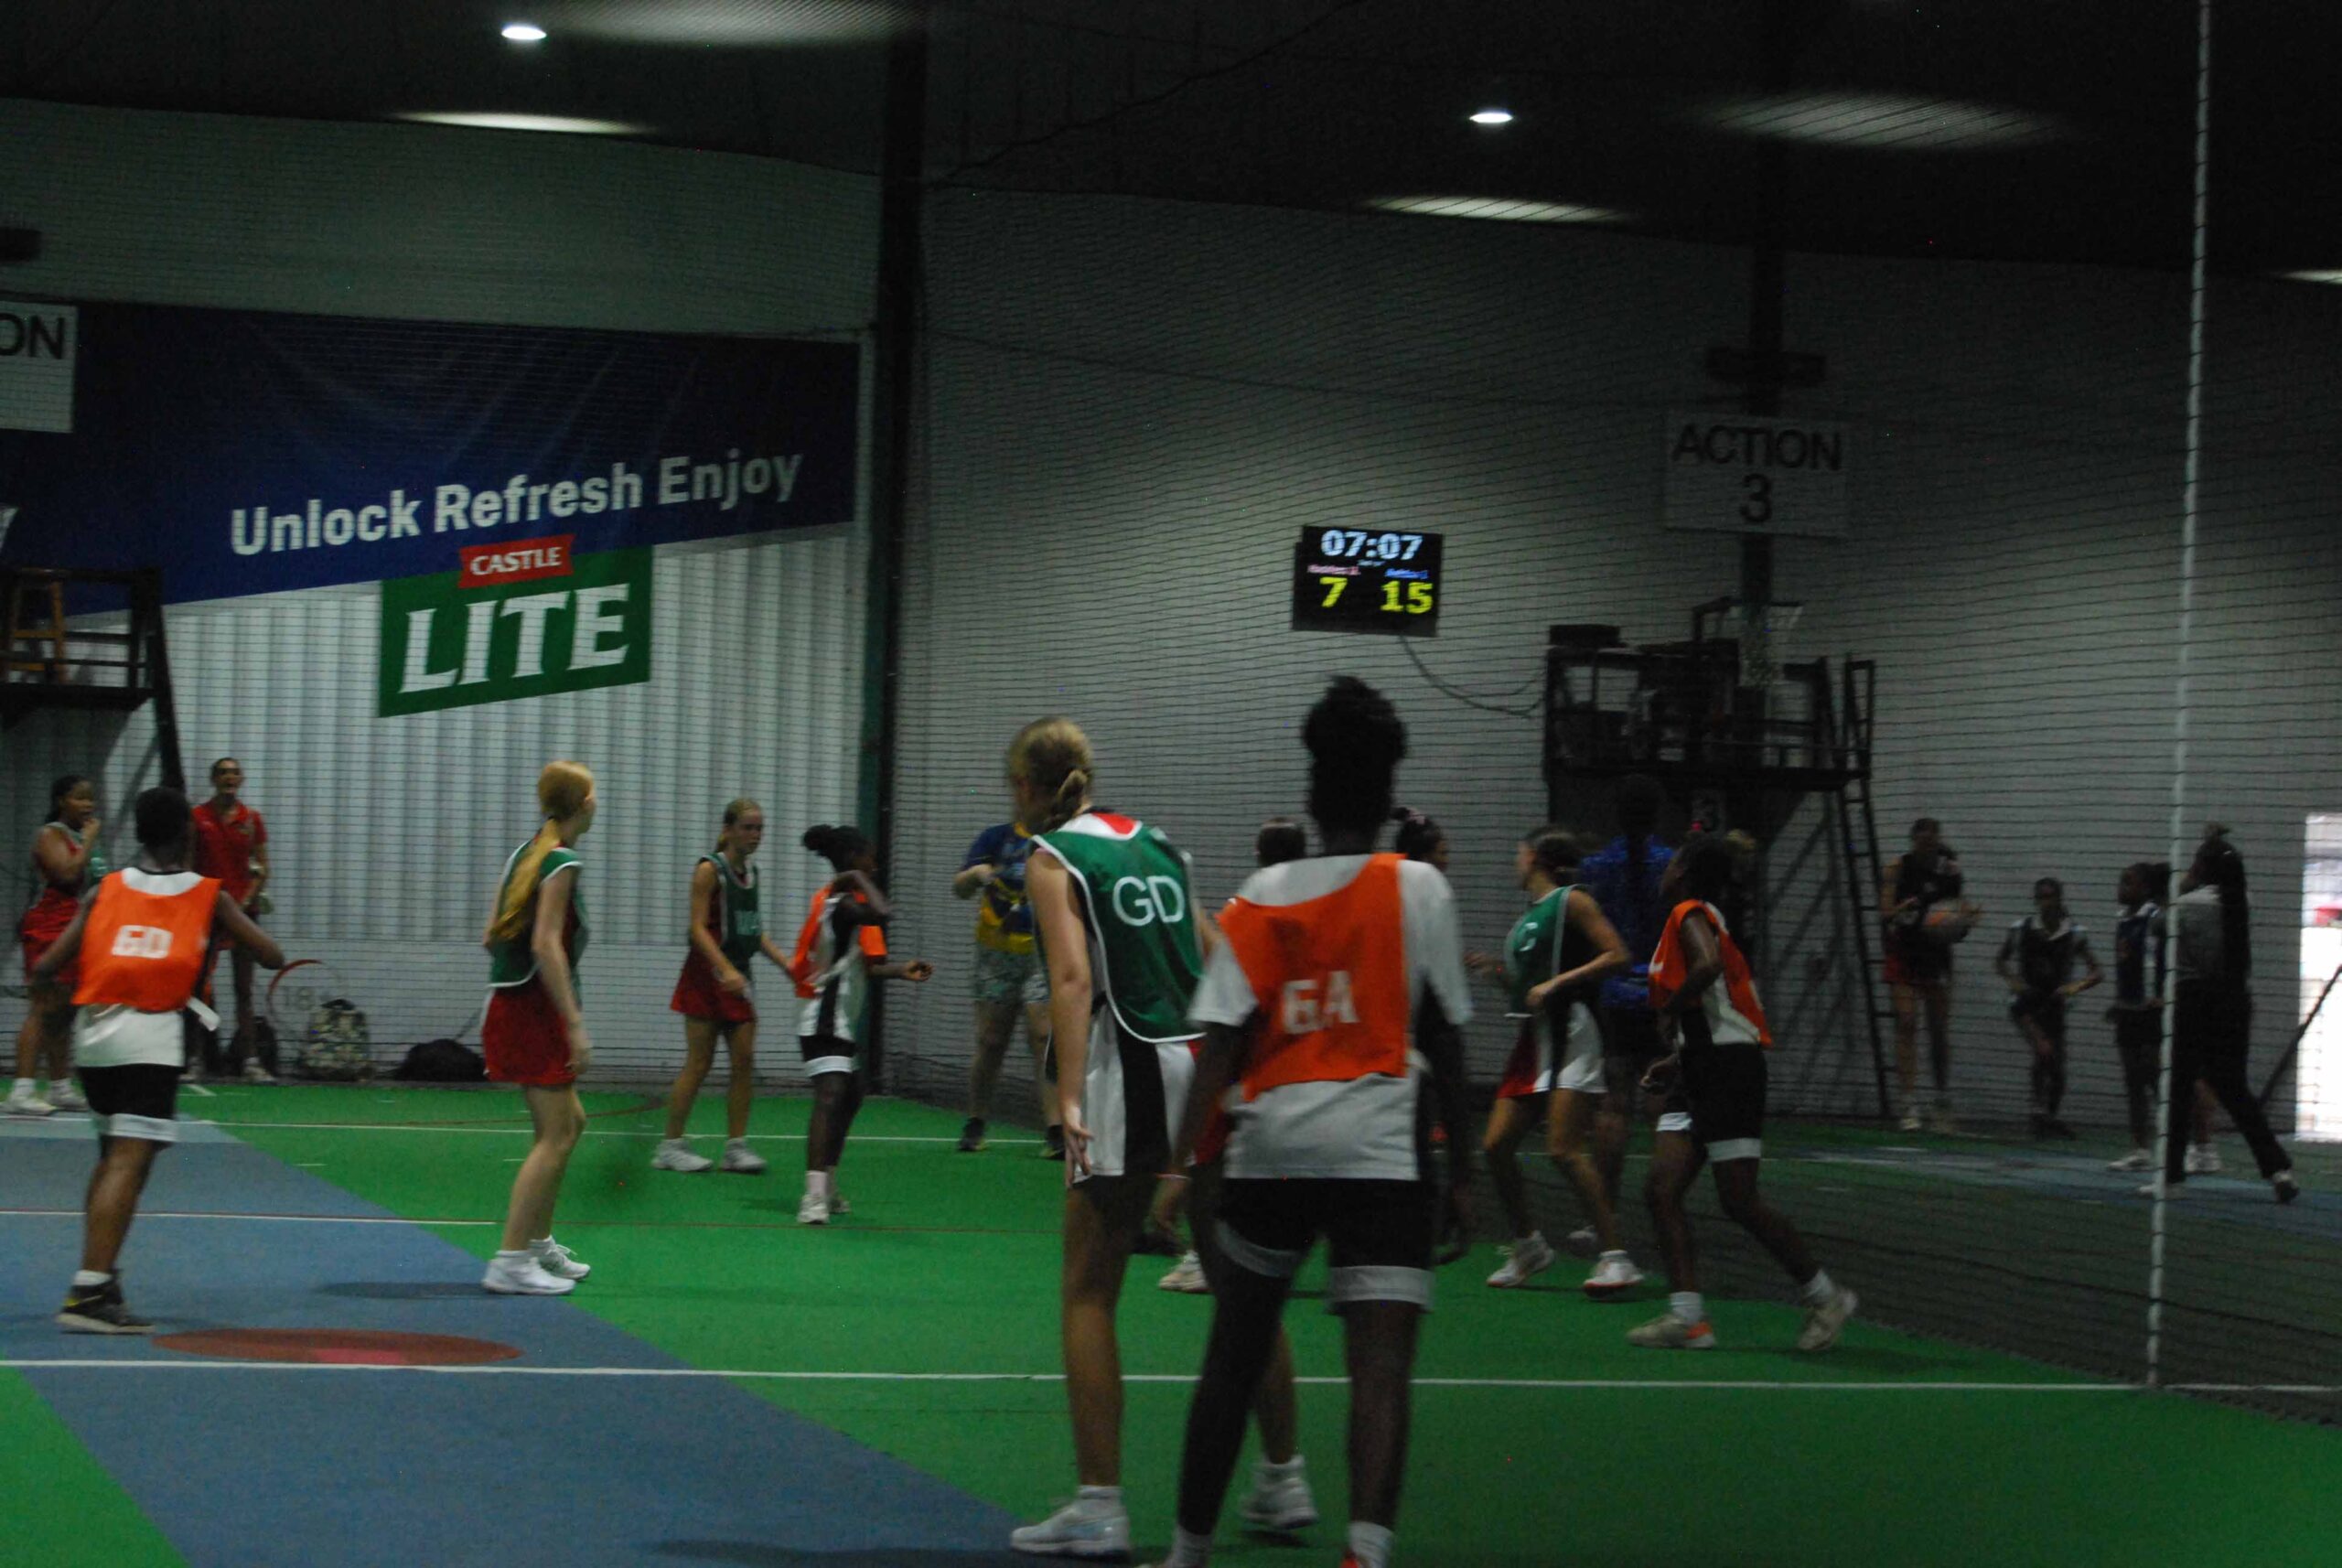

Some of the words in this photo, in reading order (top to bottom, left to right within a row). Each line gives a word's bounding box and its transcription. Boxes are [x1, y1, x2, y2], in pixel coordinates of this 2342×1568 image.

[1671, 424, 1842, 470] ACTION
[231, 489, 423, 555] Unlock
[434, 461, 643, 533] Refresh
[657, 447, 804, 511] Enjoy
[1741, 473, 1773, 522] 3
[469, 547, 563, 576] CASTLE
[1320, 530, 1423, 560] 07:07
[1319, 576, 1348, 608] 7
[1380, 580, 1434, 614] 15
[398, 583, 631, 693] LITE
[1112, 875, 1186, 927] GD
